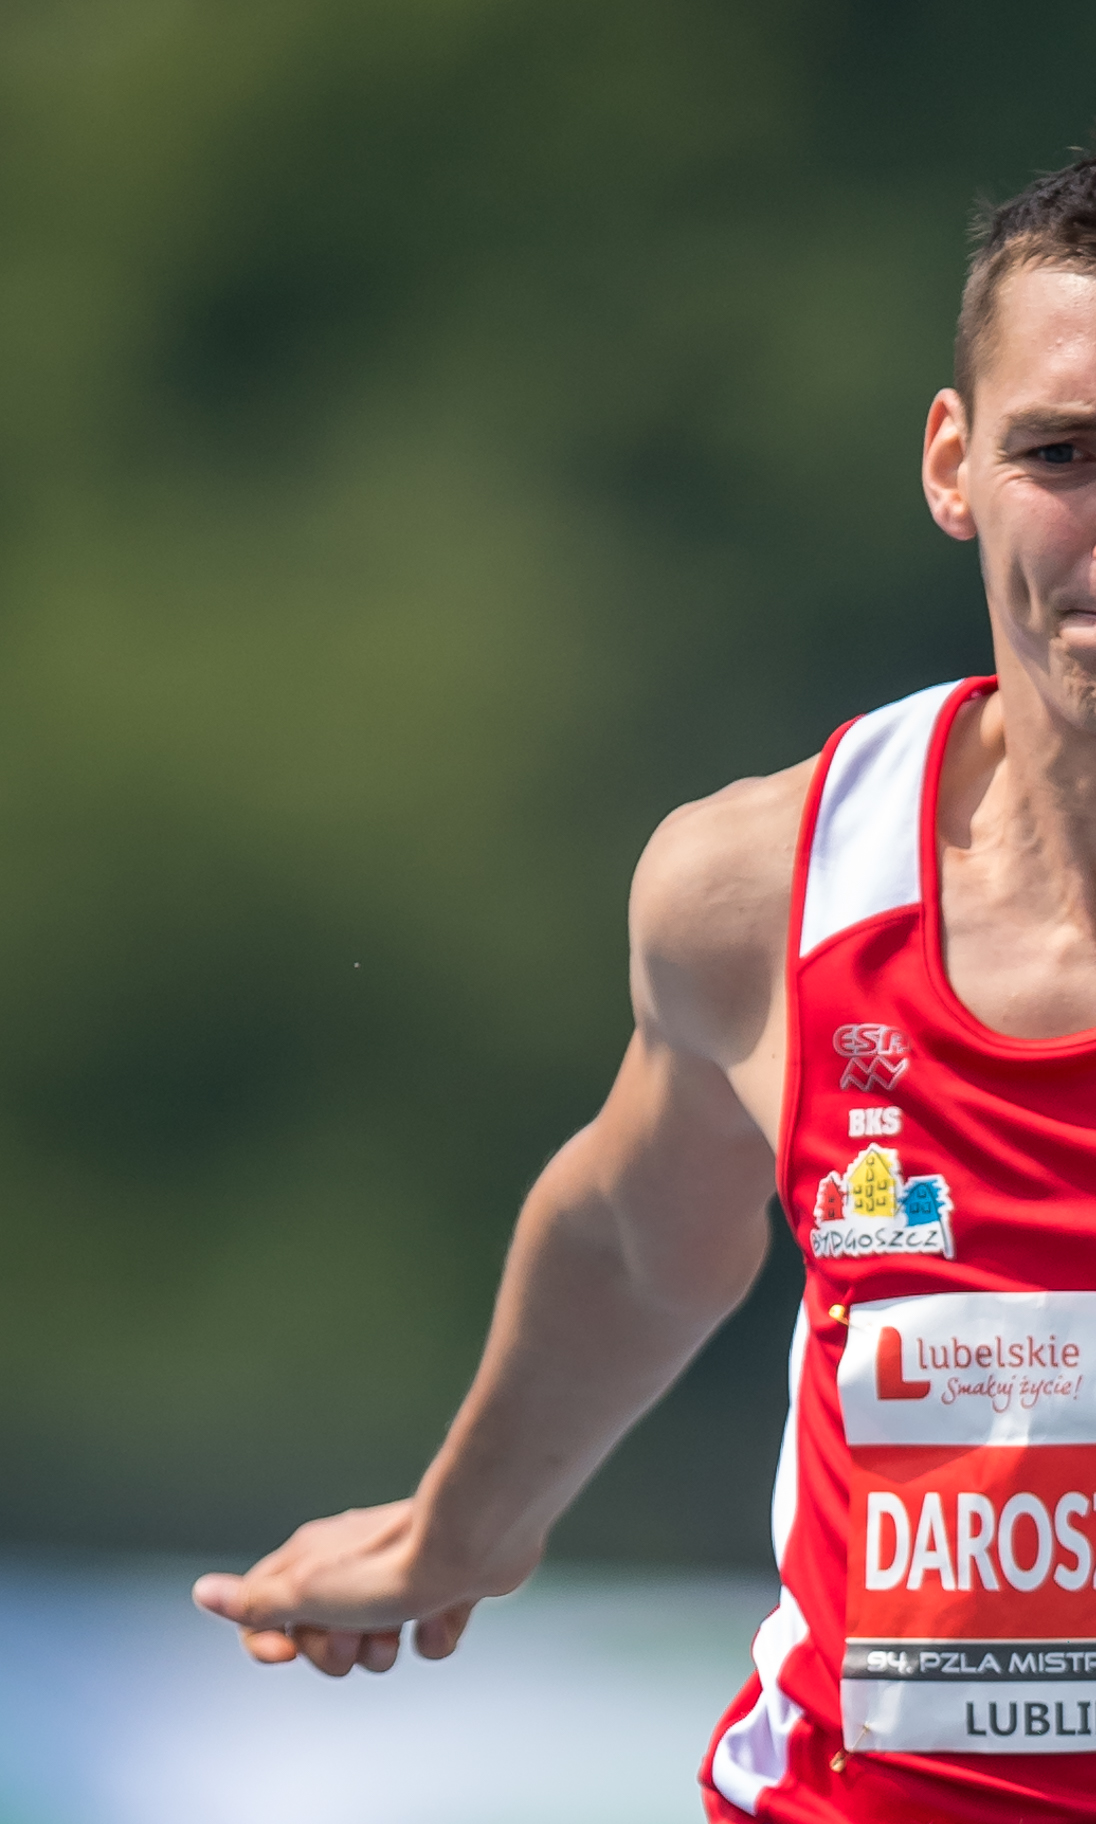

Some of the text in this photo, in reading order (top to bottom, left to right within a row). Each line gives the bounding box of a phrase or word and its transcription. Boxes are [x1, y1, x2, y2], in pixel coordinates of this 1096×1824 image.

[848, 1106, 903, 1137] BKS
[812, 1227, 938, 1252] BYDGOSZCZ
[941, 1374, 1083, 1413] Smakuj życie!
[867, 1650, 913, 1674] 94.
[920, 1651, 1001, 1673] PZLA
